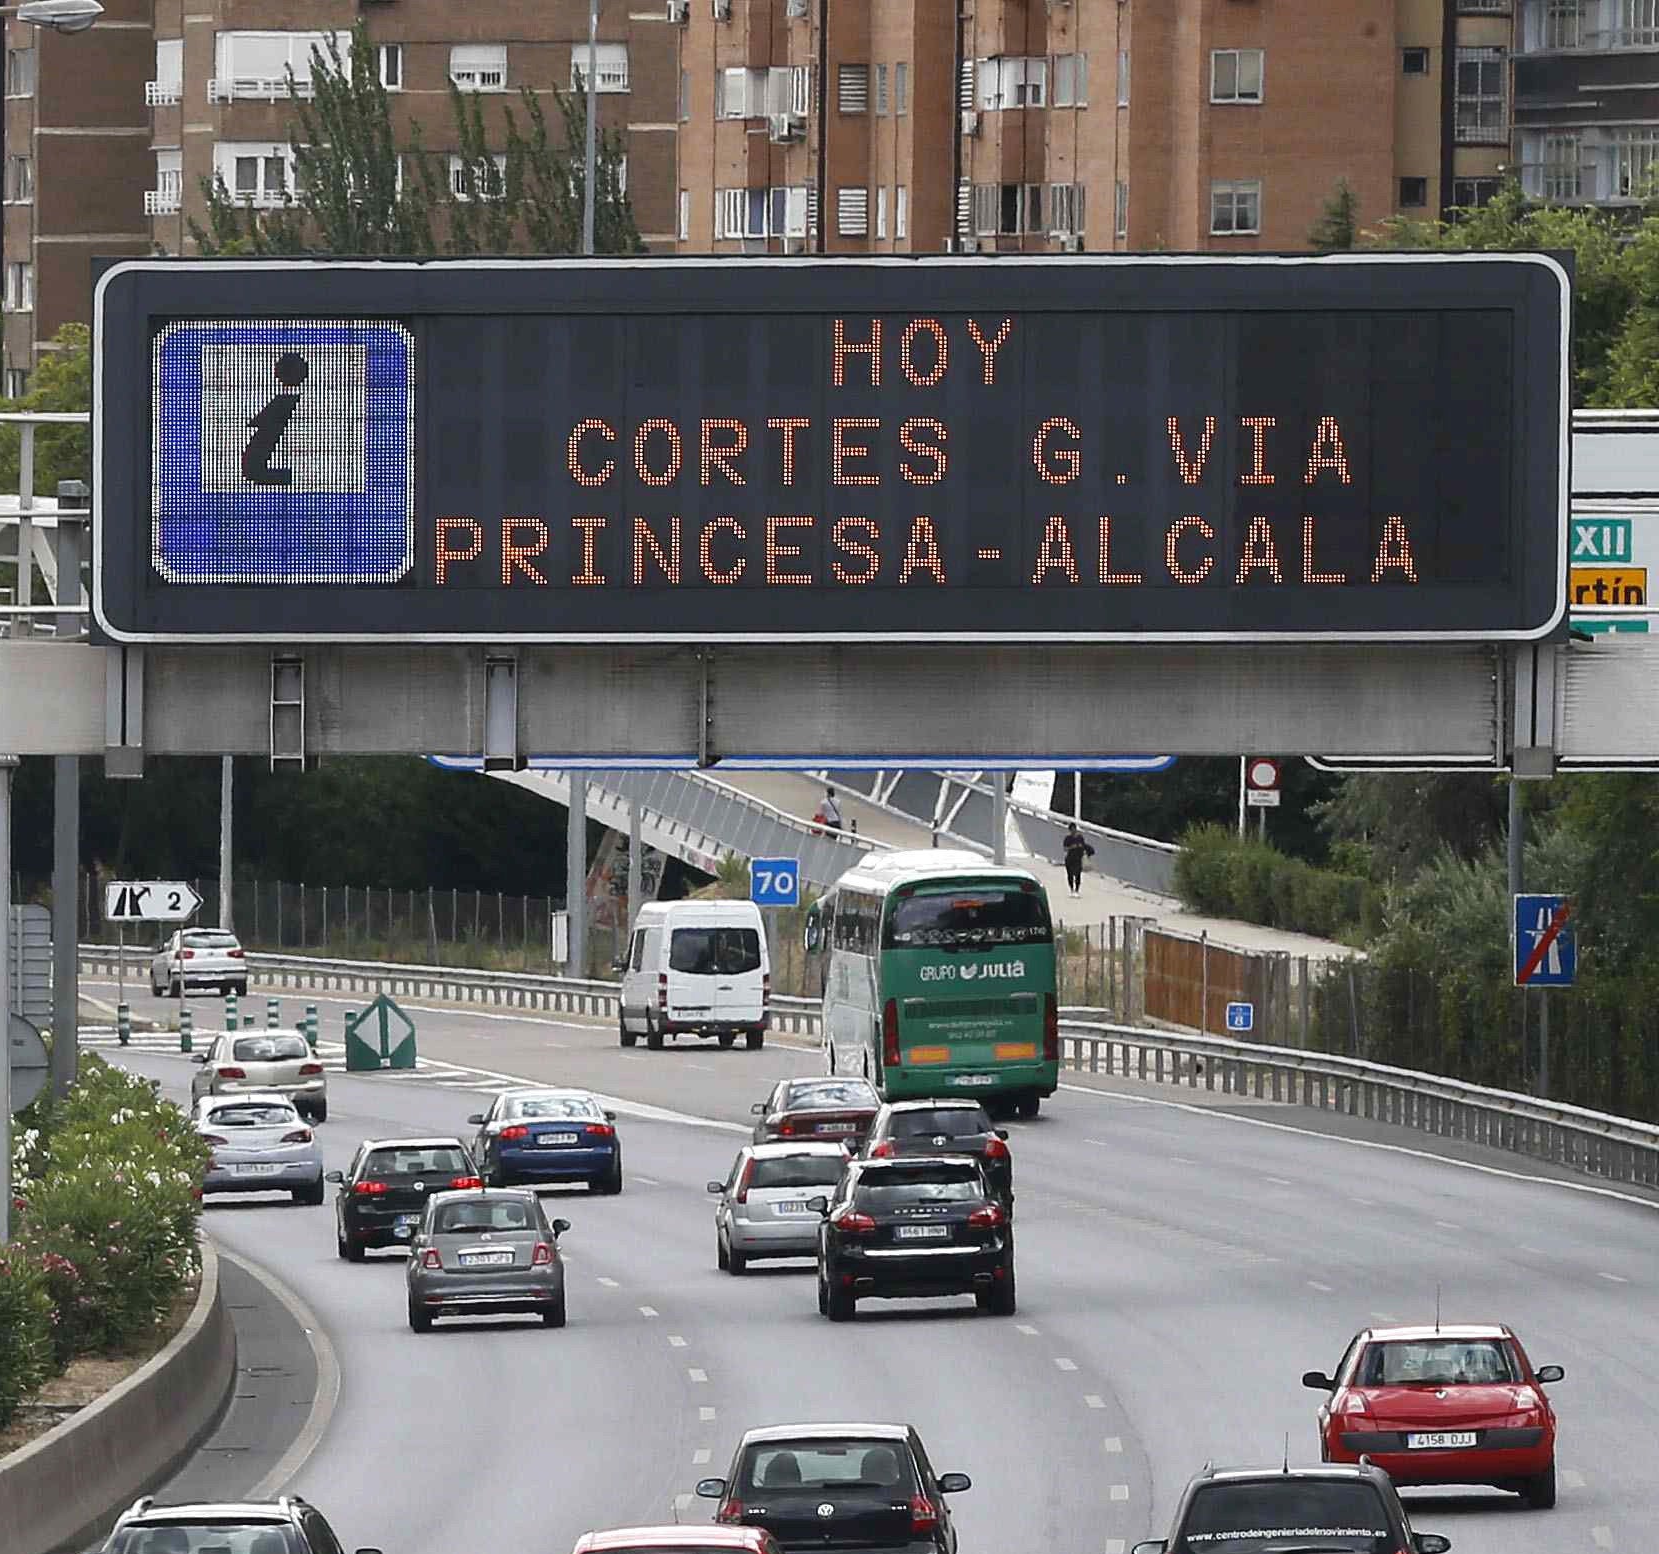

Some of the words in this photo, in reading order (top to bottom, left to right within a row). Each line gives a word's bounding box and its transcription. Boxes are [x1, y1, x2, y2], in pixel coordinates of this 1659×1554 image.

[833, 318, 1012, 385] HOY
[567, 416, 947, 486] CORTES
[756, 872, 793, 894] 70
[168, 892, 181, 911] 2
[920, 965, 956, 981] GRUPO
[1418, 1434, 1444, 1446] 4158
